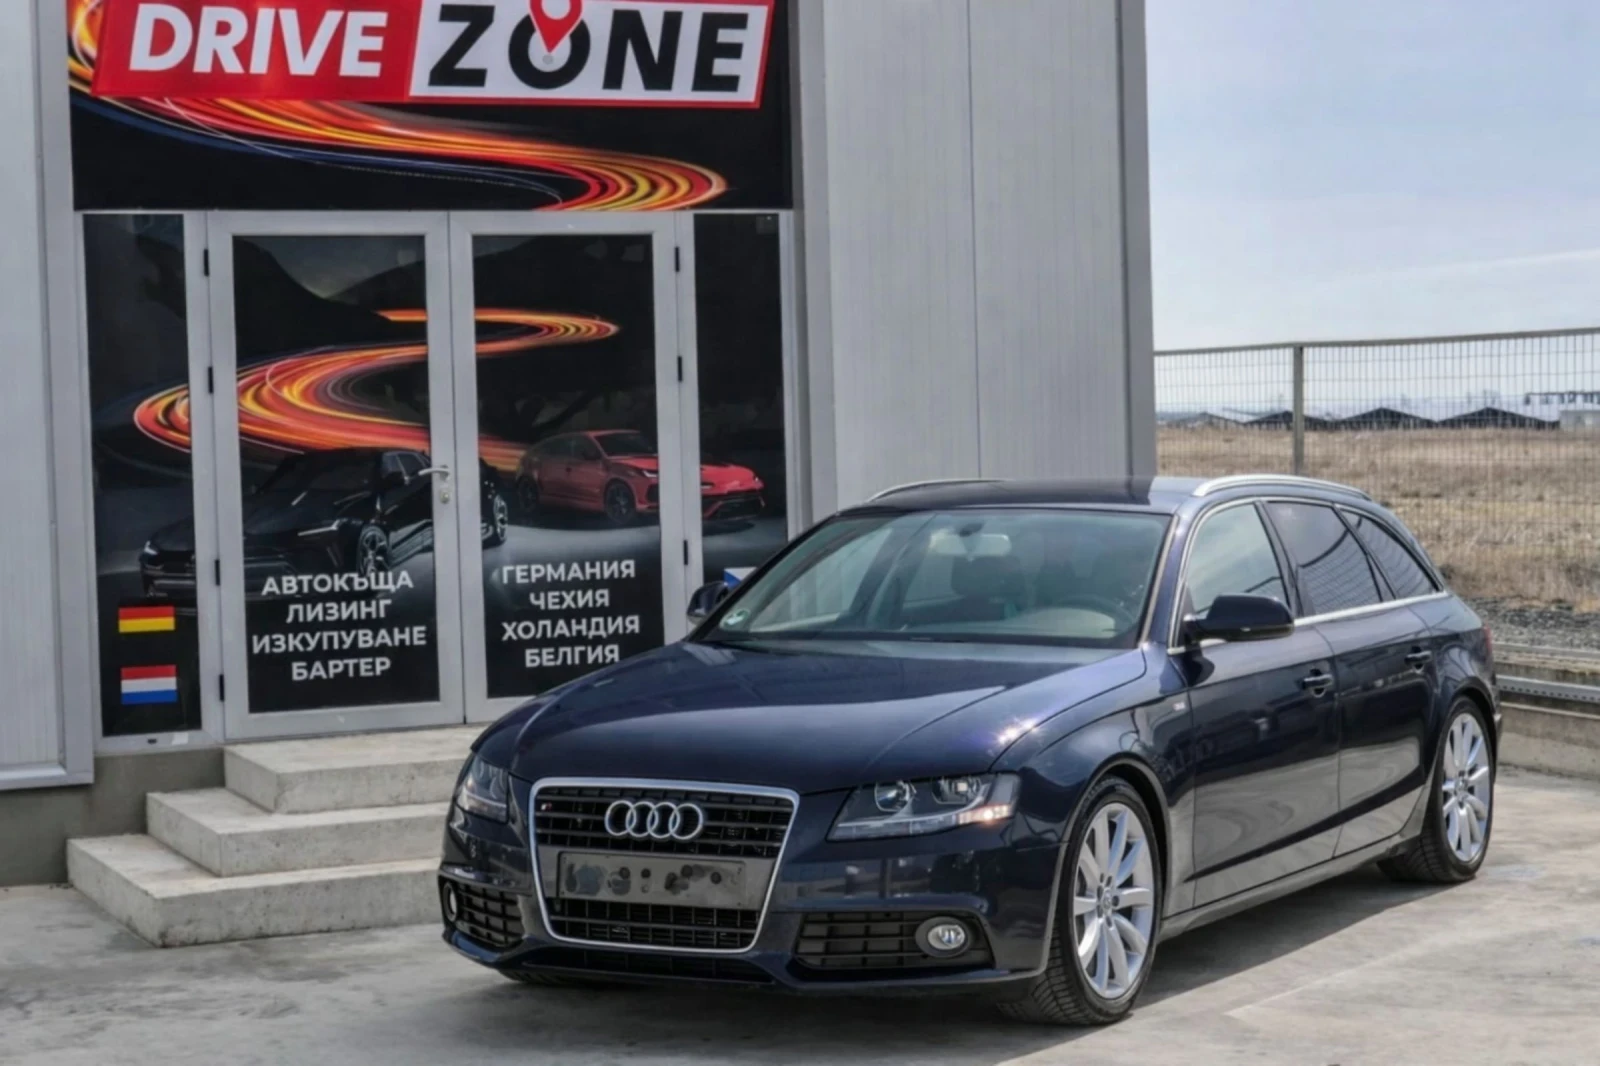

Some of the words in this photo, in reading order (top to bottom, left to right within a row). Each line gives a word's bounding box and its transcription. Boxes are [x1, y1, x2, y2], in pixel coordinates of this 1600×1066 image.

[129, 3, 388, 77] DRIVE
[428, 4, 749, 92] ZONE
[261, 570, 414, 596] АВТОКЪЩА
[502, 559, 636, 584] ГЕРМАНИЯ
[286, 599, 392, 624] ЛИЗИНГ
[529, 588, 610, 610] ЧЕХИЯ
[252, 626, 427, 654] ИЗКУПУВАНЕ
[501, 615, 640, 641] ХОЛАНДИЯ
[525, 644, 620, 668] БЕЛГИЯ
[291, 657, 391, 681] БАРТЕР
